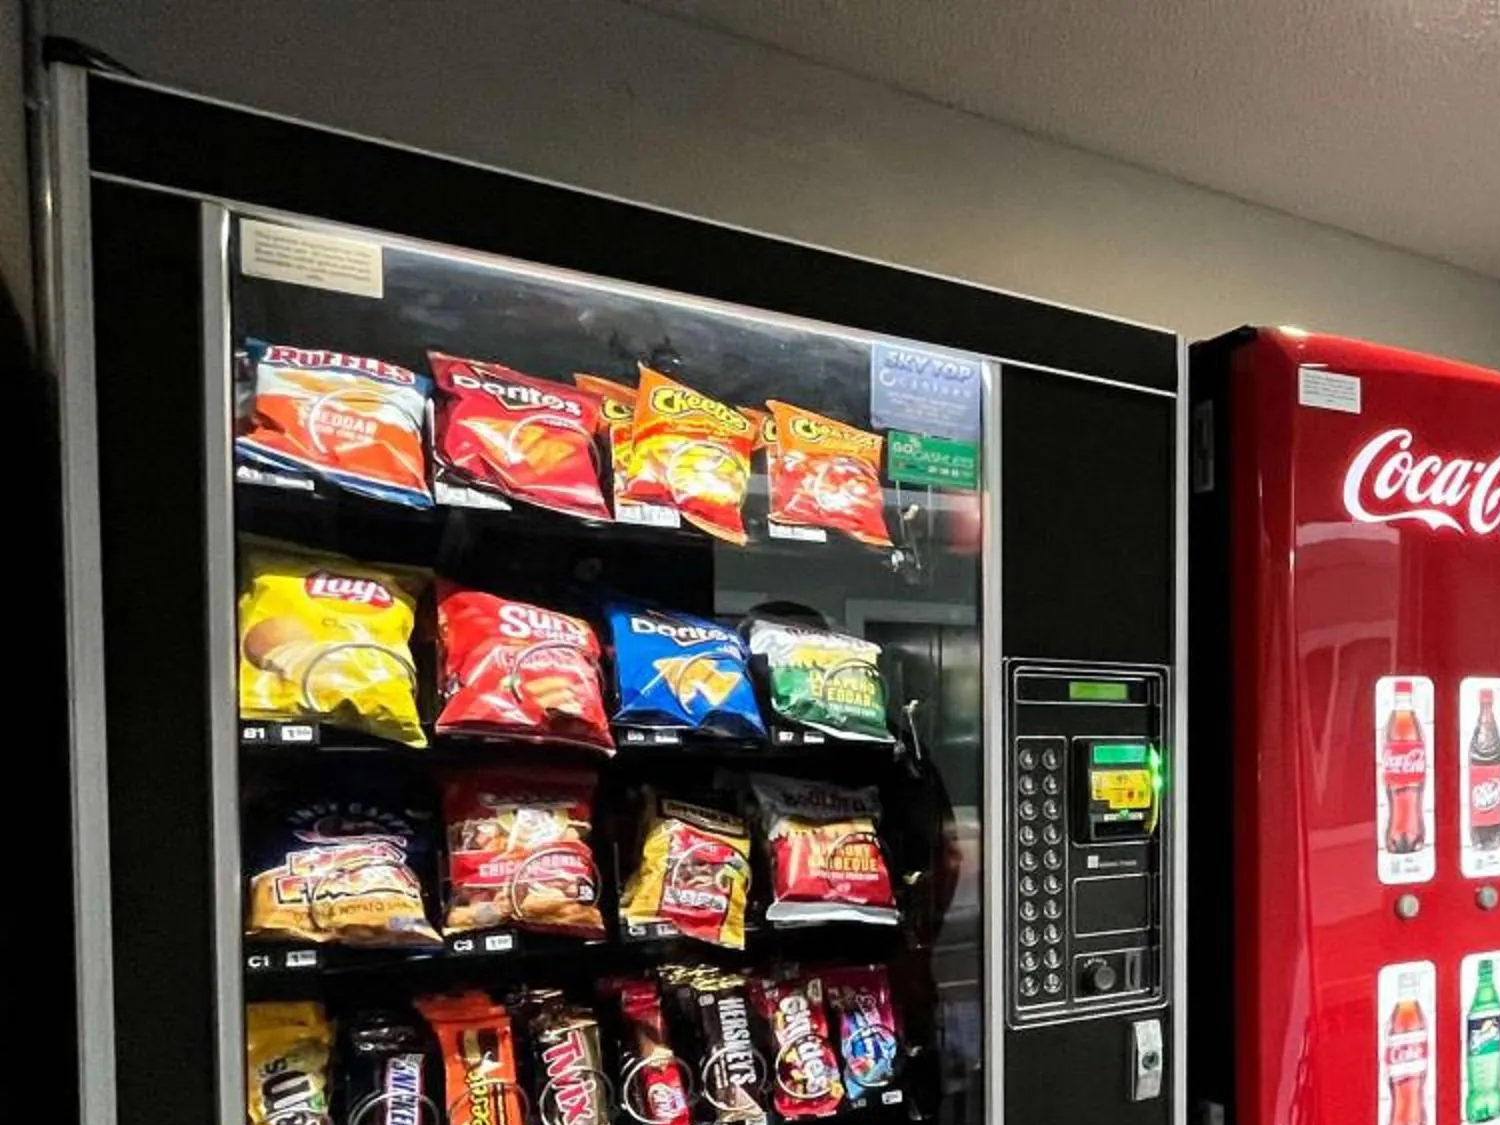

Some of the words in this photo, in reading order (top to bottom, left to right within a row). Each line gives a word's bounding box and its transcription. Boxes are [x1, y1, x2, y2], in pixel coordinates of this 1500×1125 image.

[452, 374, 582, 416] Doritos
[243, 727, 266, 739] B1
[453, 939, 474, 951] C3
[247, 956, 269, 967] C1
